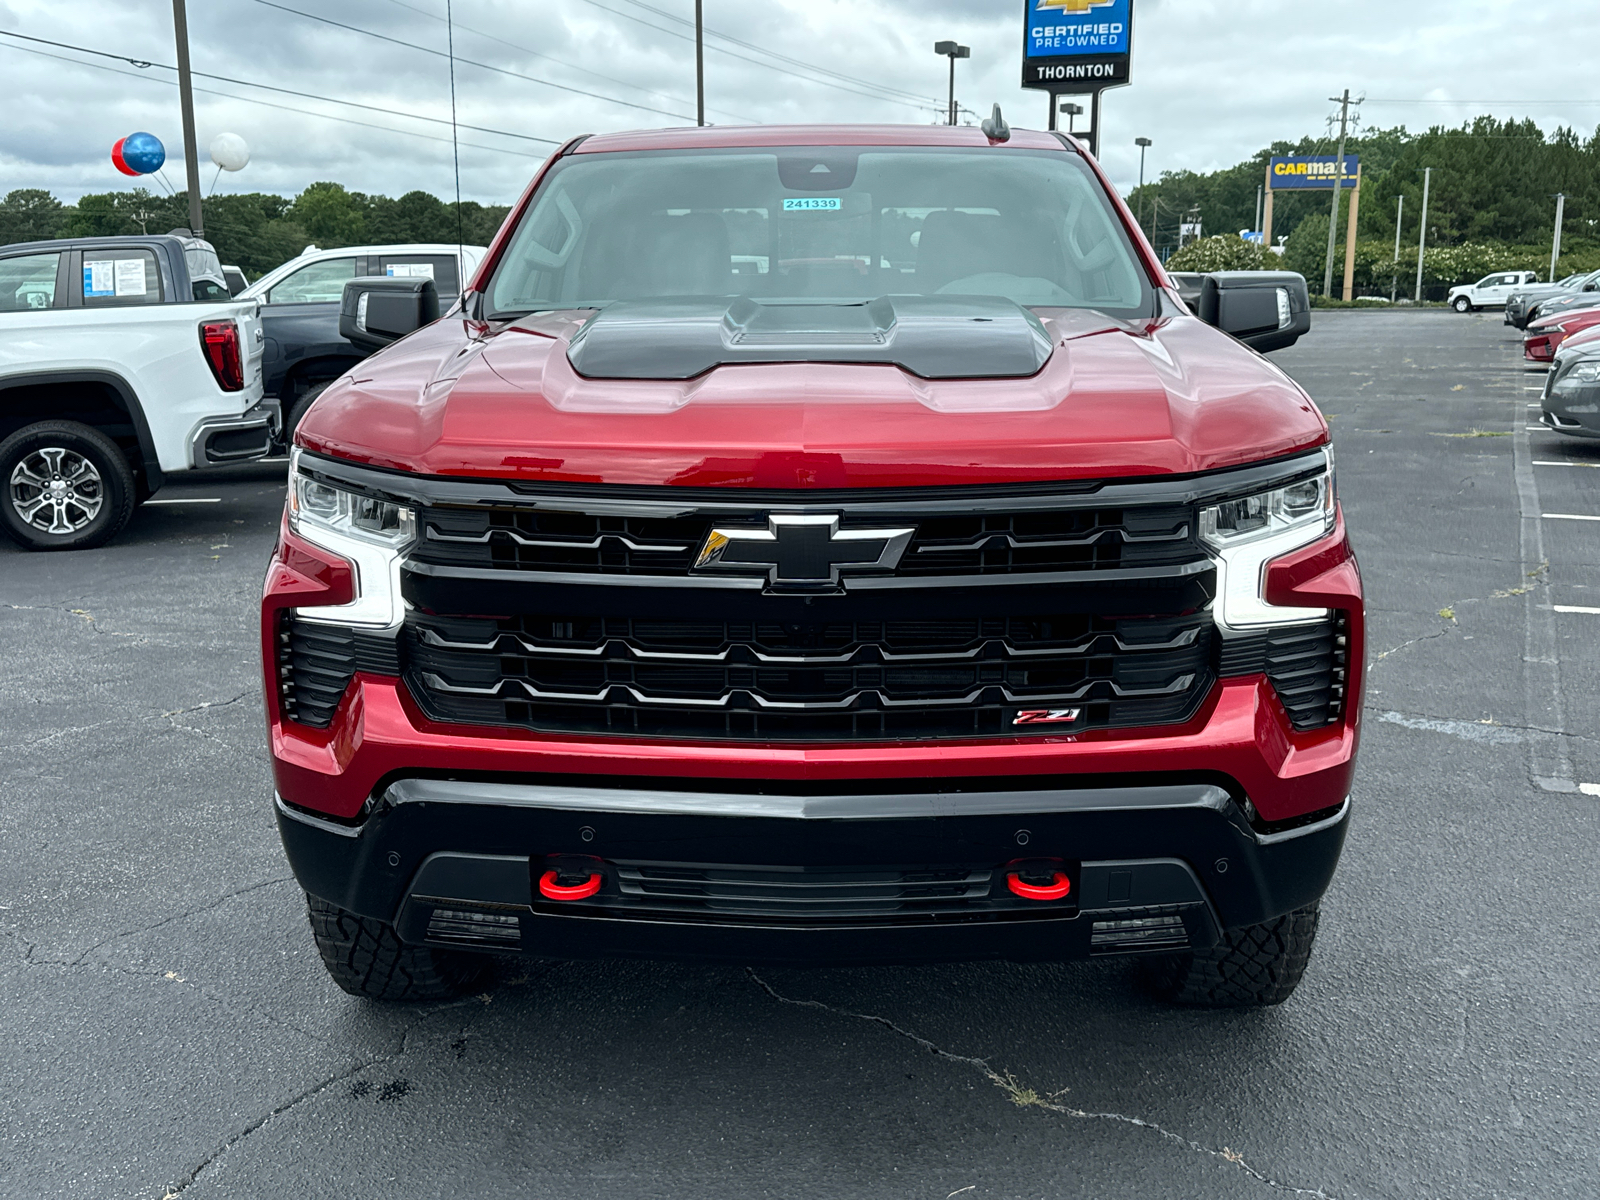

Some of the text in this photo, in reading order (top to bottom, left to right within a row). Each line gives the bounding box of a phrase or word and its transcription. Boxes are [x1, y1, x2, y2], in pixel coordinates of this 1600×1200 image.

[1031, 23, 1123, 38] CERTIFIED
[1035, 34, 1118, 48] PRE-OWNED
[1037, 63, 1114, 79] THORNTON
[786, 200, 837, 208] 241339
[1012, 708, 1081, 725] Z71
